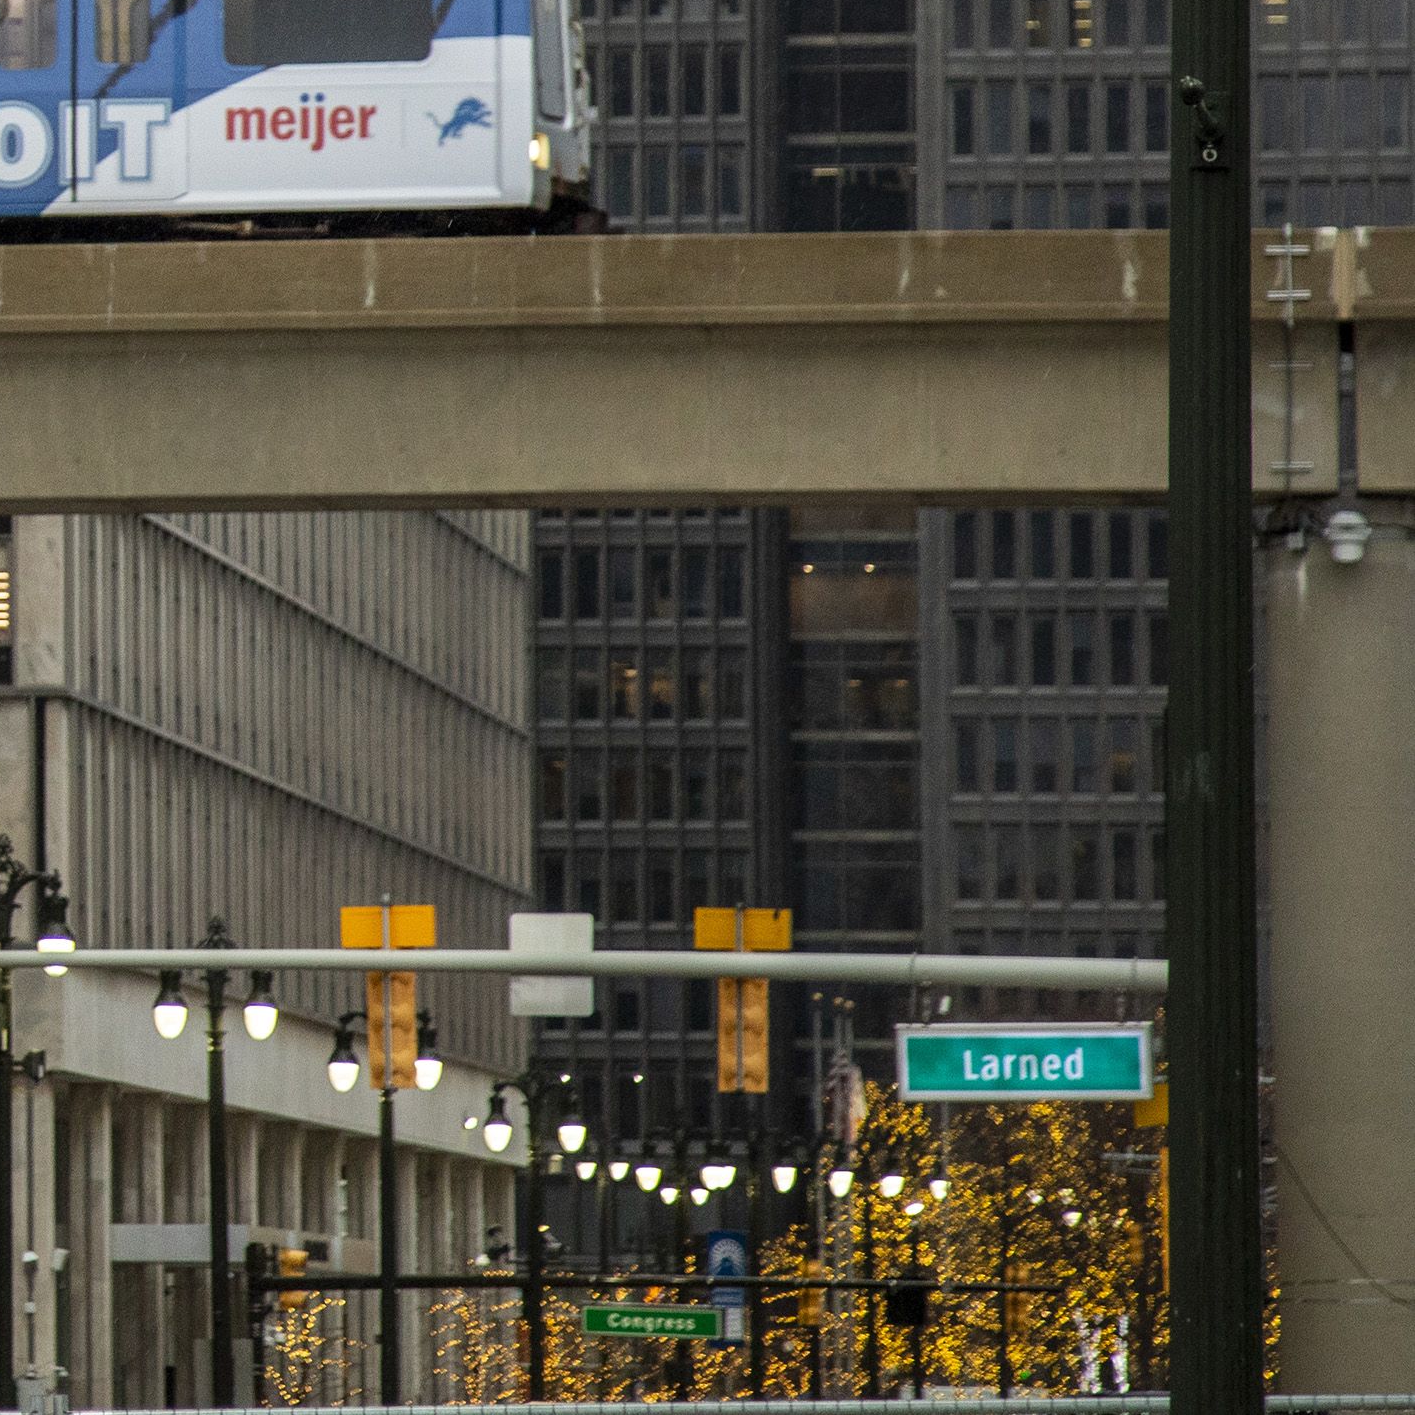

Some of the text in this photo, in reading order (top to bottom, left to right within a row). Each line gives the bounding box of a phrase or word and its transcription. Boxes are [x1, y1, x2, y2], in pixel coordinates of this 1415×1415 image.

[225, 93, 377, 152] meijer
[963, 1046, 1085, 1082] Larned
[606, 1312, 697, 1333] Congress
